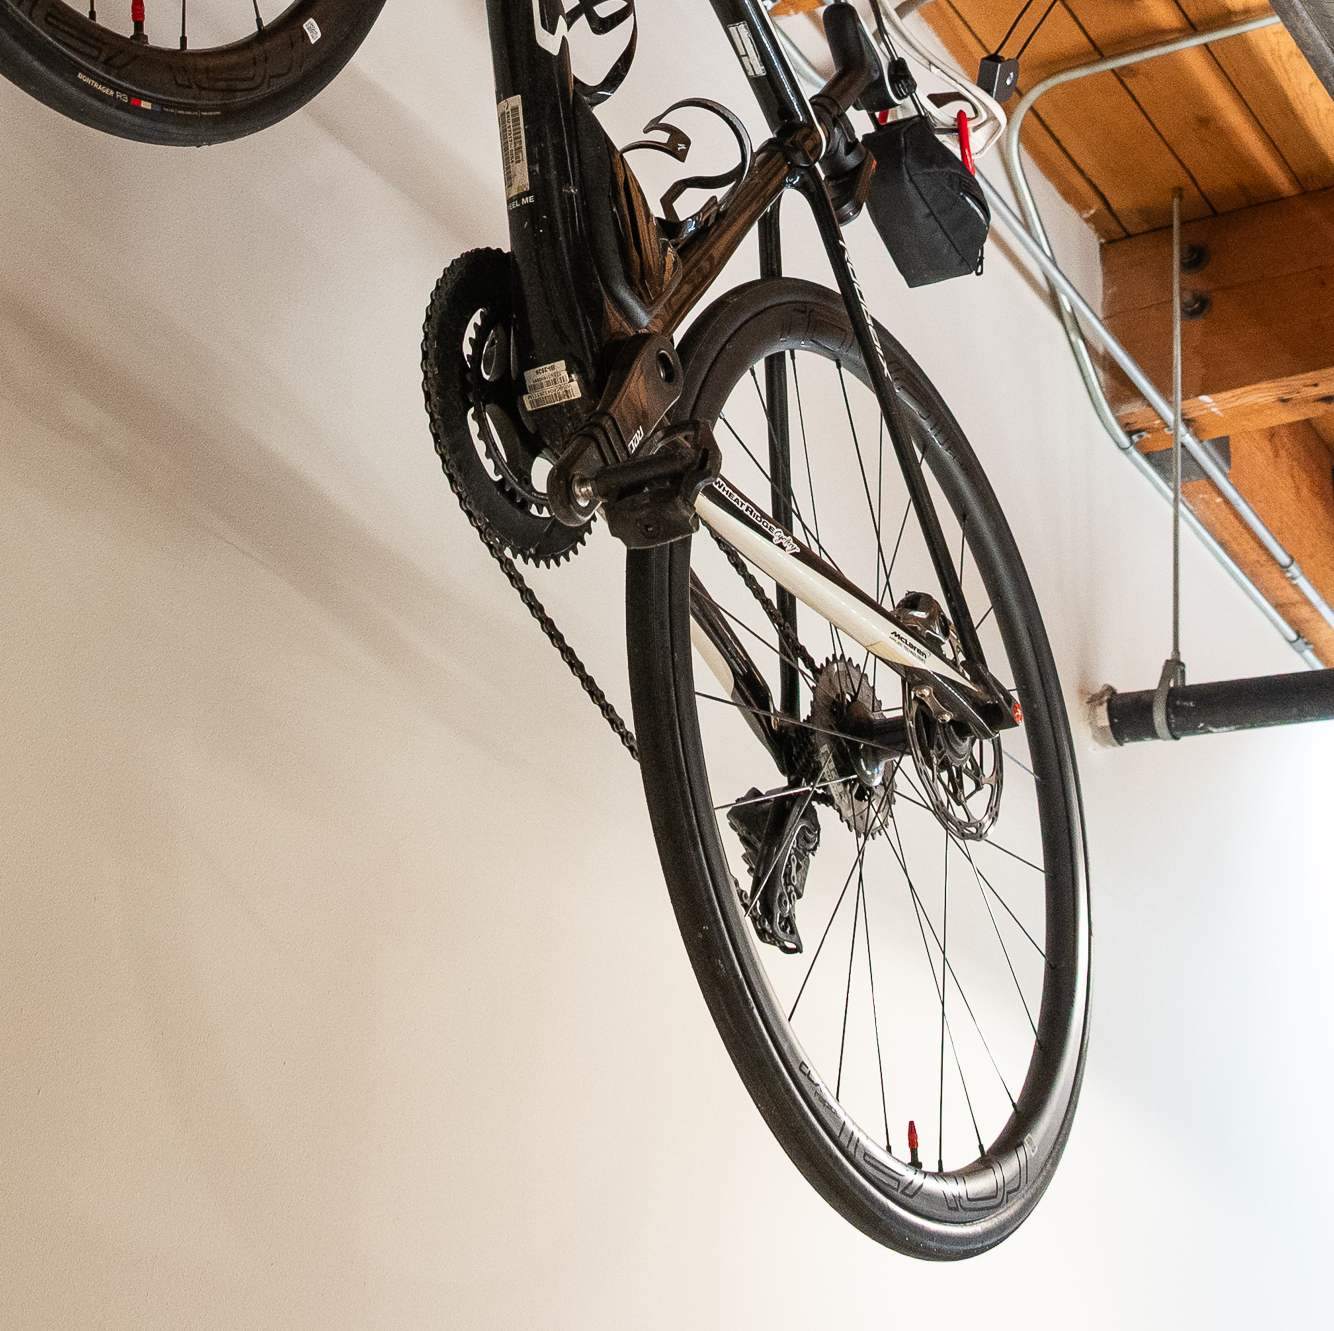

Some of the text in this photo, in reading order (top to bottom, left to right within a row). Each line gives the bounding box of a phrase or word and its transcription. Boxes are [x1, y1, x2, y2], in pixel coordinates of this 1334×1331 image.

[77, 72, 128, 103] BONTRAGER R3
[521, 195, 535, 205] ME
[714, 480, 744, 510] WHEAT
[745, 506, 775, 534] RIDGE
[890, 631, 927, 659] McLaren
